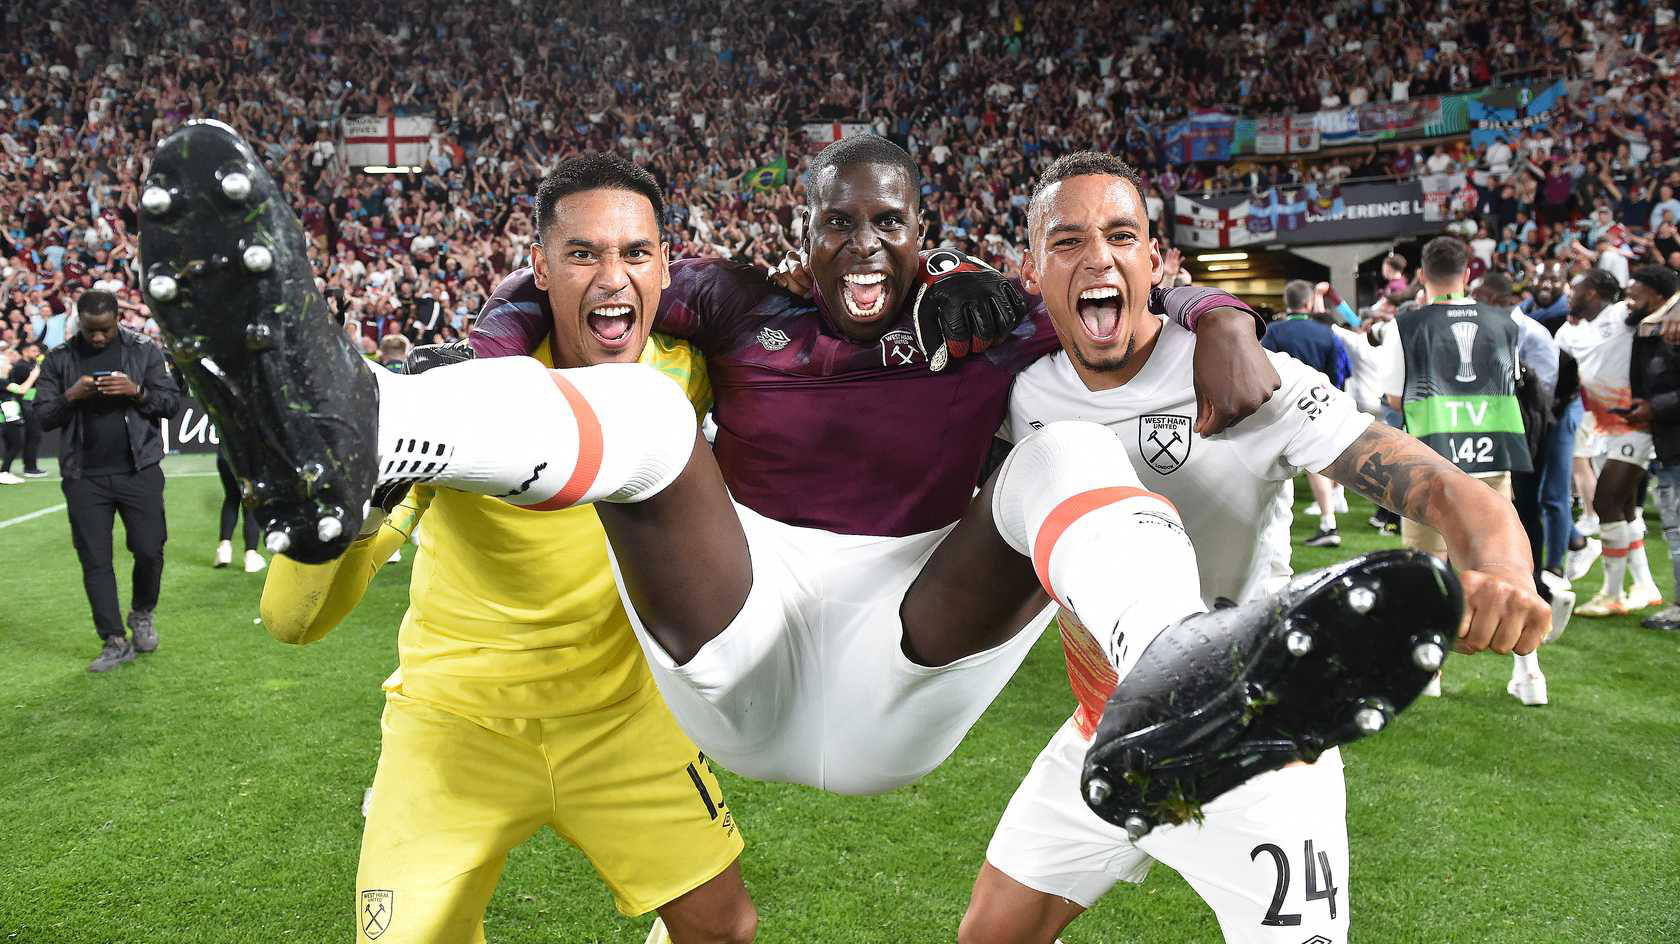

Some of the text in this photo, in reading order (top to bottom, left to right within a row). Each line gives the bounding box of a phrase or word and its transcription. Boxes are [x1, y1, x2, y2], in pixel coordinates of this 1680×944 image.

[1145, 417, 1187, 426] WEST HAM
[1444, 401, 1489, 427] TV
[1449, 436, 1495, 464] 142
[1250, 839, 1338, 927] 24
